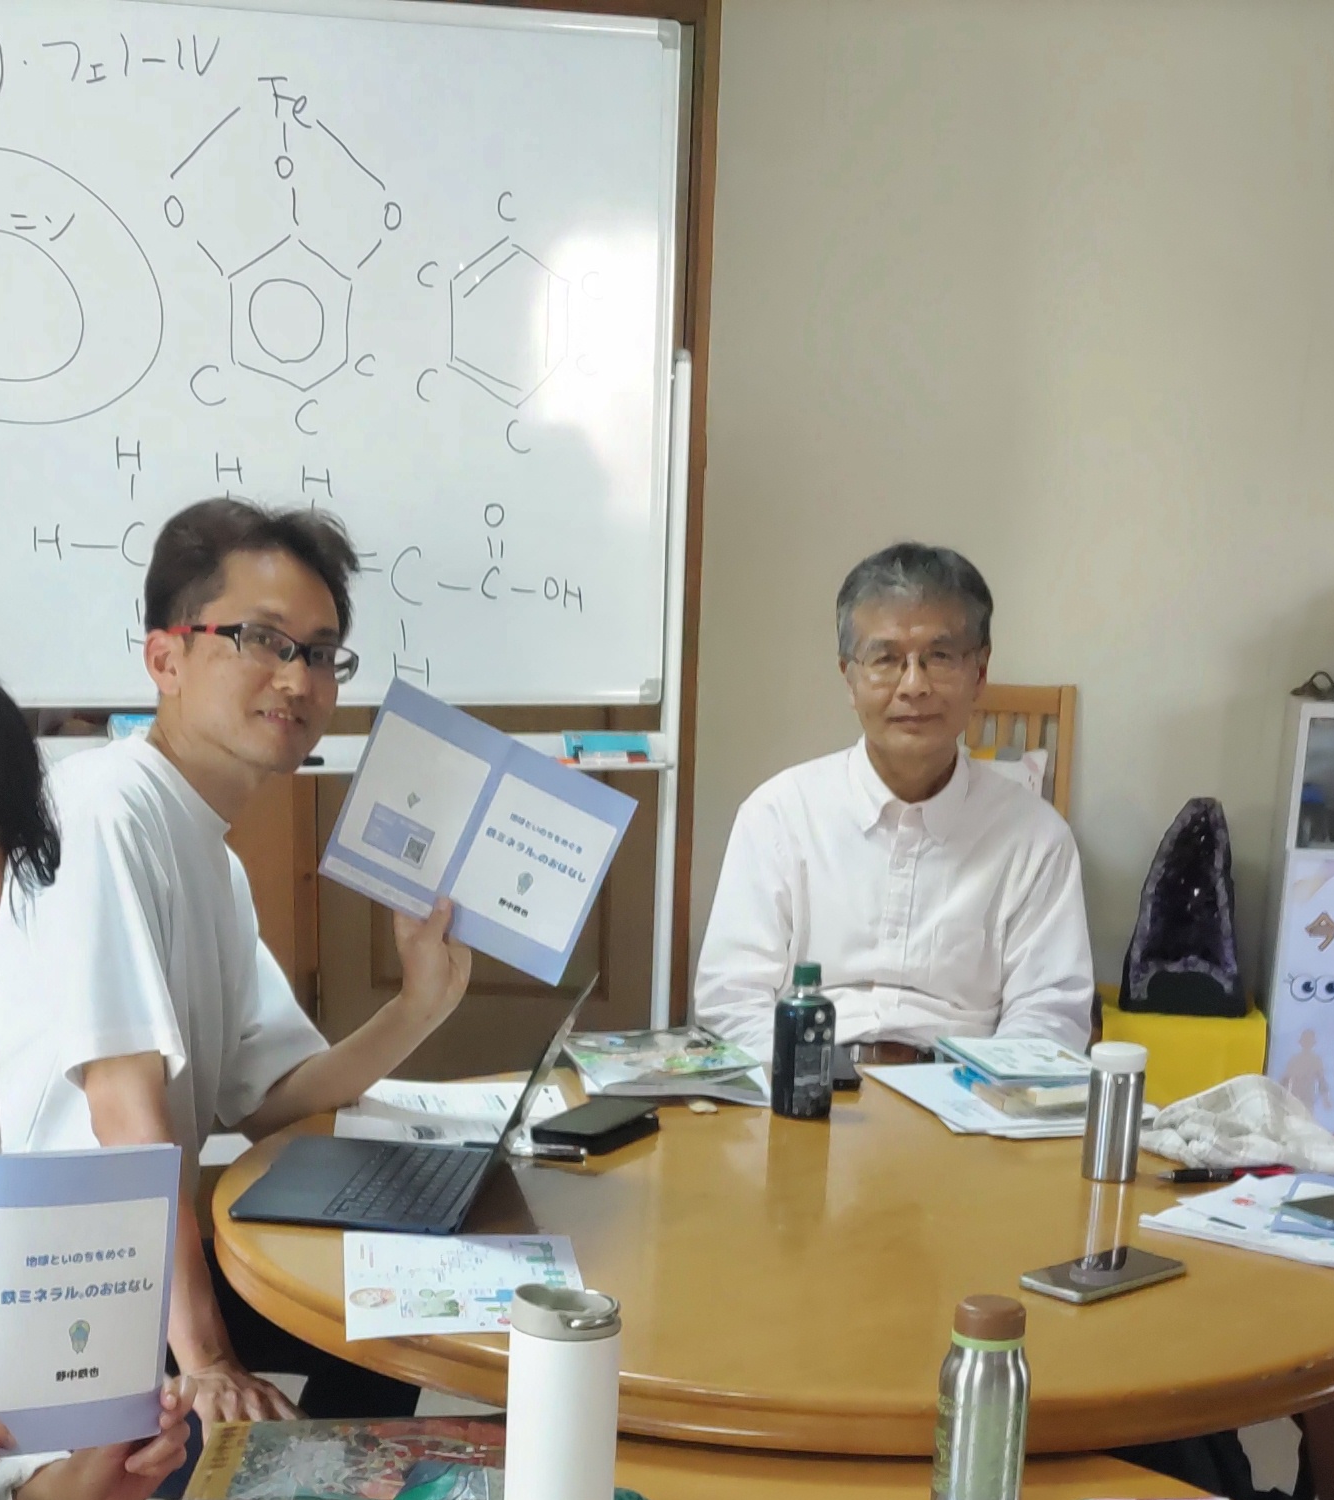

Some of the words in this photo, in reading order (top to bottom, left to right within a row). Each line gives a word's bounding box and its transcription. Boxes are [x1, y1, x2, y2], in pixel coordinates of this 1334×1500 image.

[259, 76, 313, 128] Fe
[116, 436, 142, 471] H
[215, 453, 244, 486] H
[302, 465, 333, 498] H
